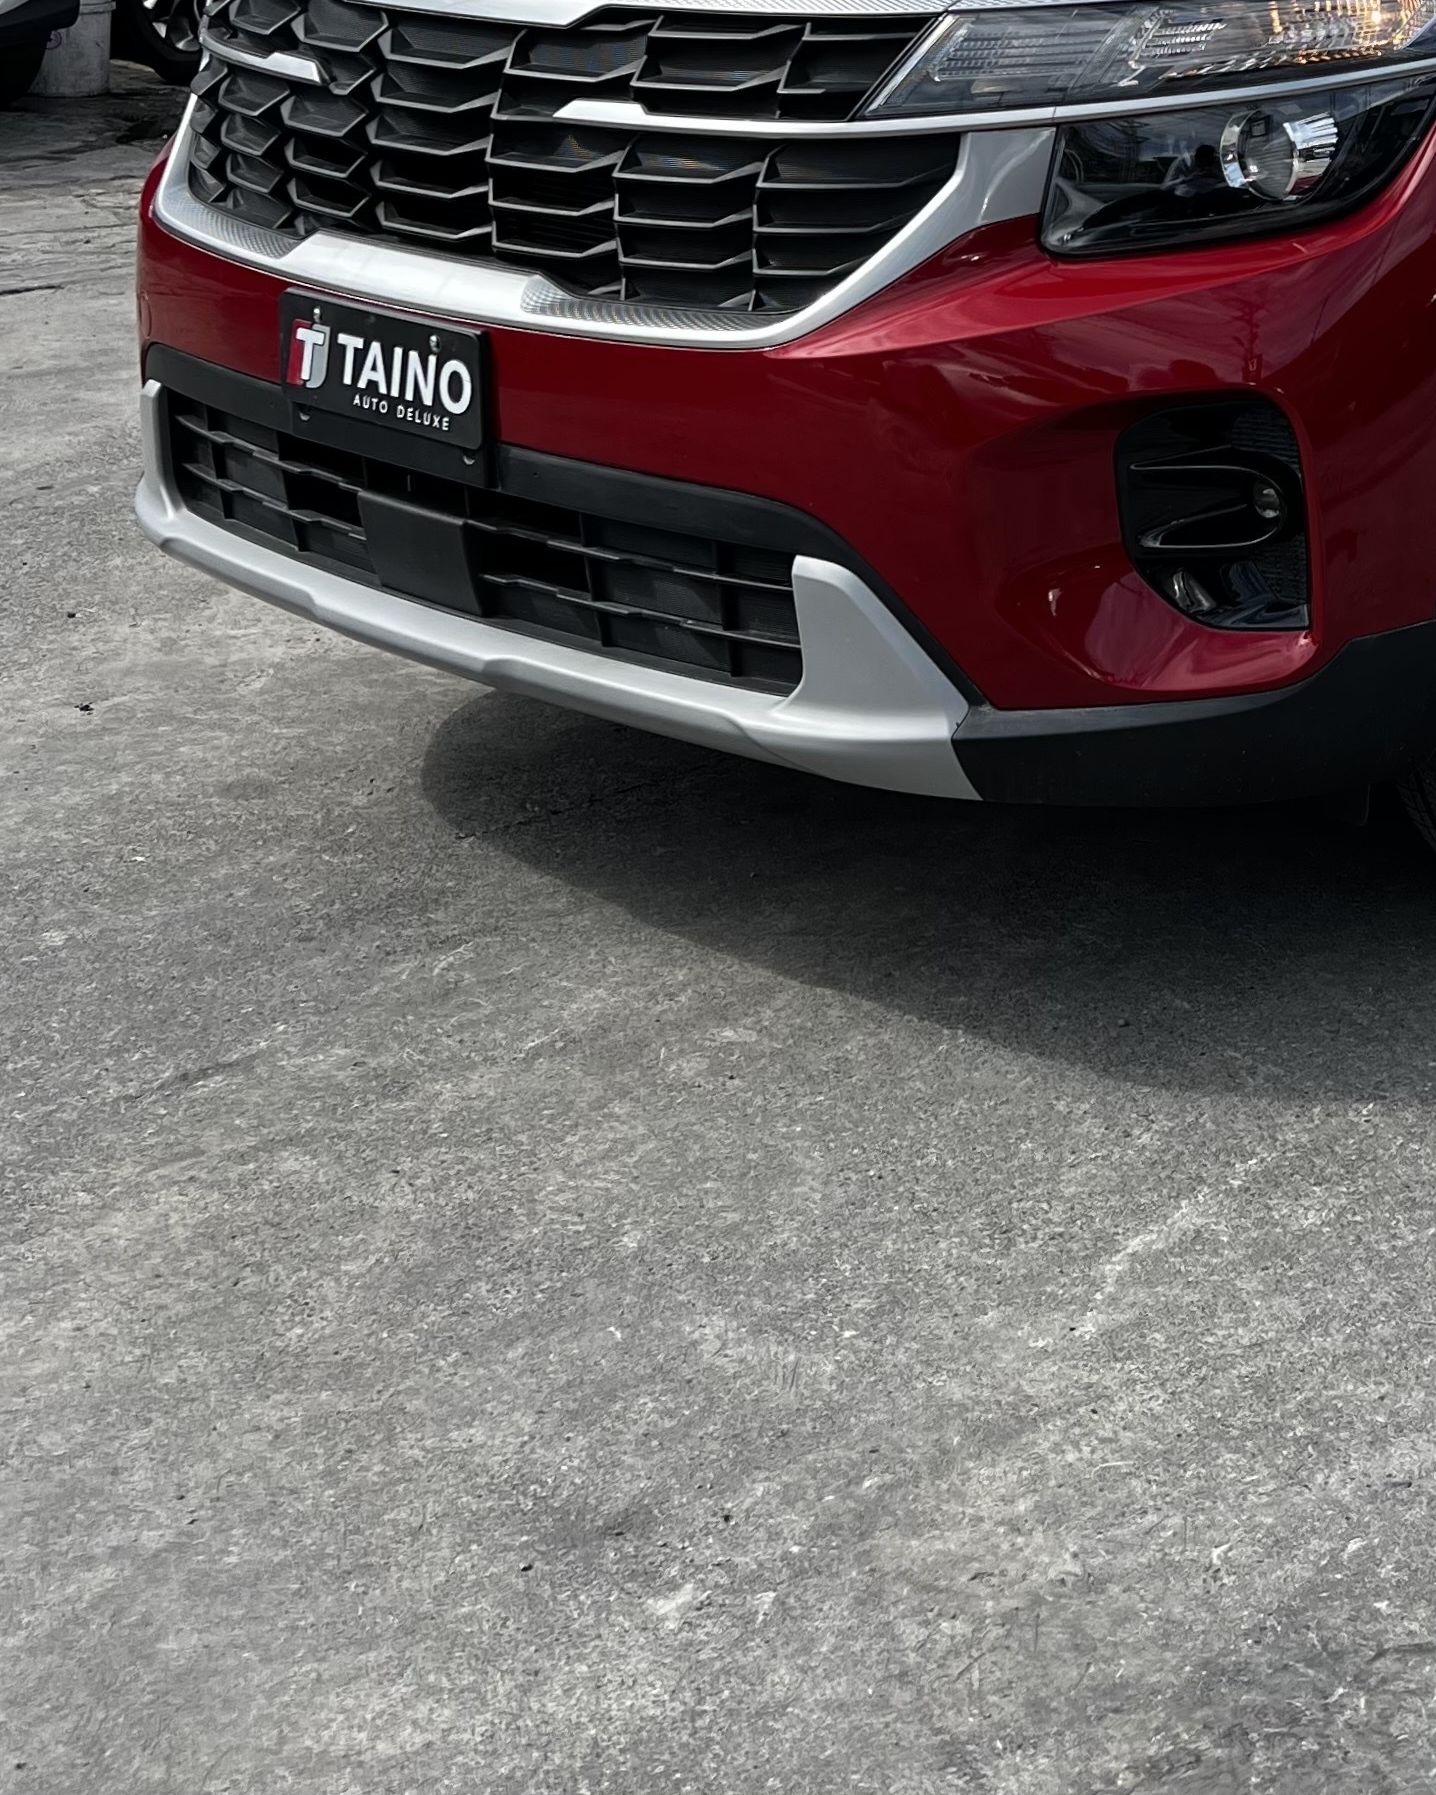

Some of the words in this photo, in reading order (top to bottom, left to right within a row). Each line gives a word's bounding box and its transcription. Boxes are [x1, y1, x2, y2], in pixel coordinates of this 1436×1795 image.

[337, 333, 472, 415] TAINO
[352, 393, 389, 414] AUTO
[396, 405, 451, 432] DELUXE
